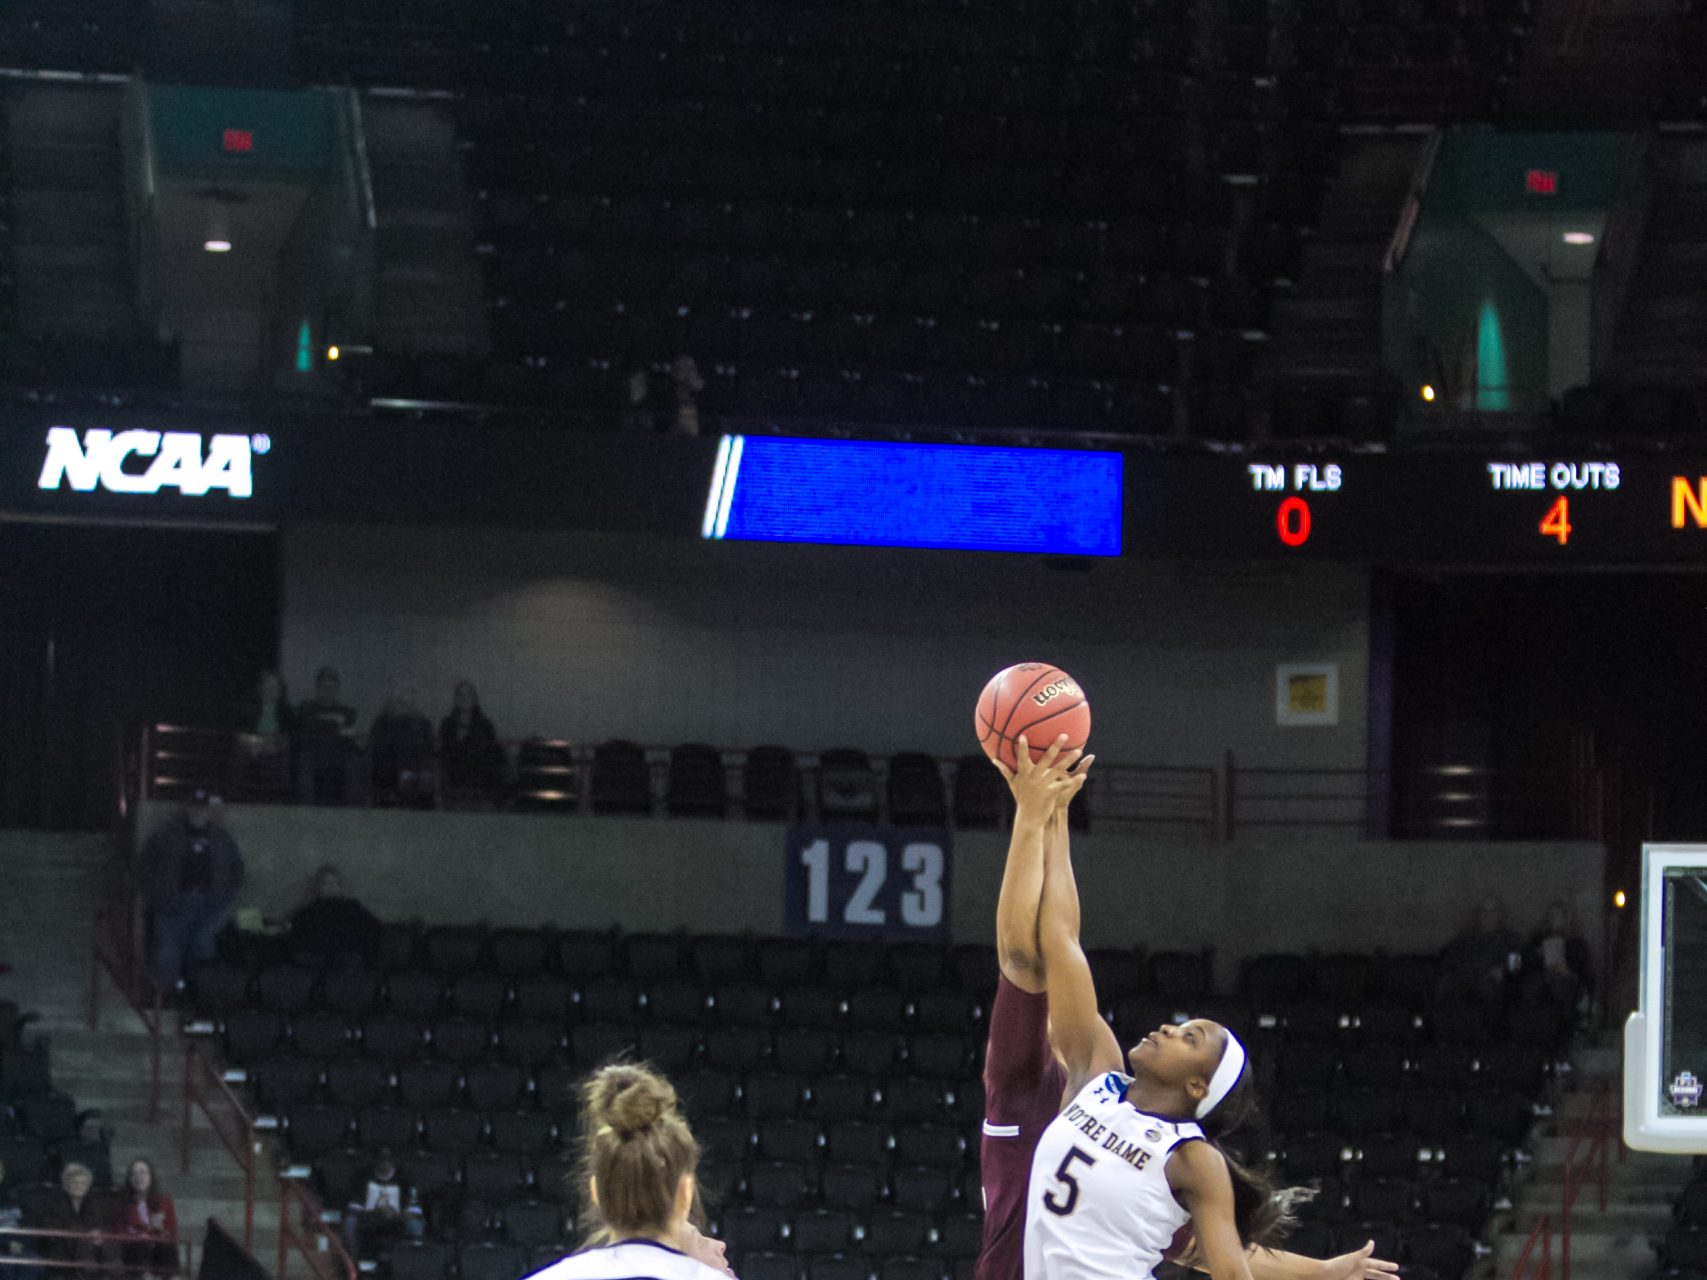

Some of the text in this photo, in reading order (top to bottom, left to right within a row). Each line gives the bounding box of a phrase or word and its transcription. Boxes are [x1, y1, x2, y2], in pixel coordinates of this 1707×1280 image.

[38, 426, 254, 498] NCAA
[1248, 463, 1343, 491] TM FLS
[1487, 462, 1621, 490] TIME OUTS
[1276, 495, 1312, 547] 0
[1538, 494, 1573, 546] 4
[801, 838, 944, 927] 123
[1062, 1102, 1152, 1172] NOTRE DAME
[1041, 1143, 1097, 1218] 5
